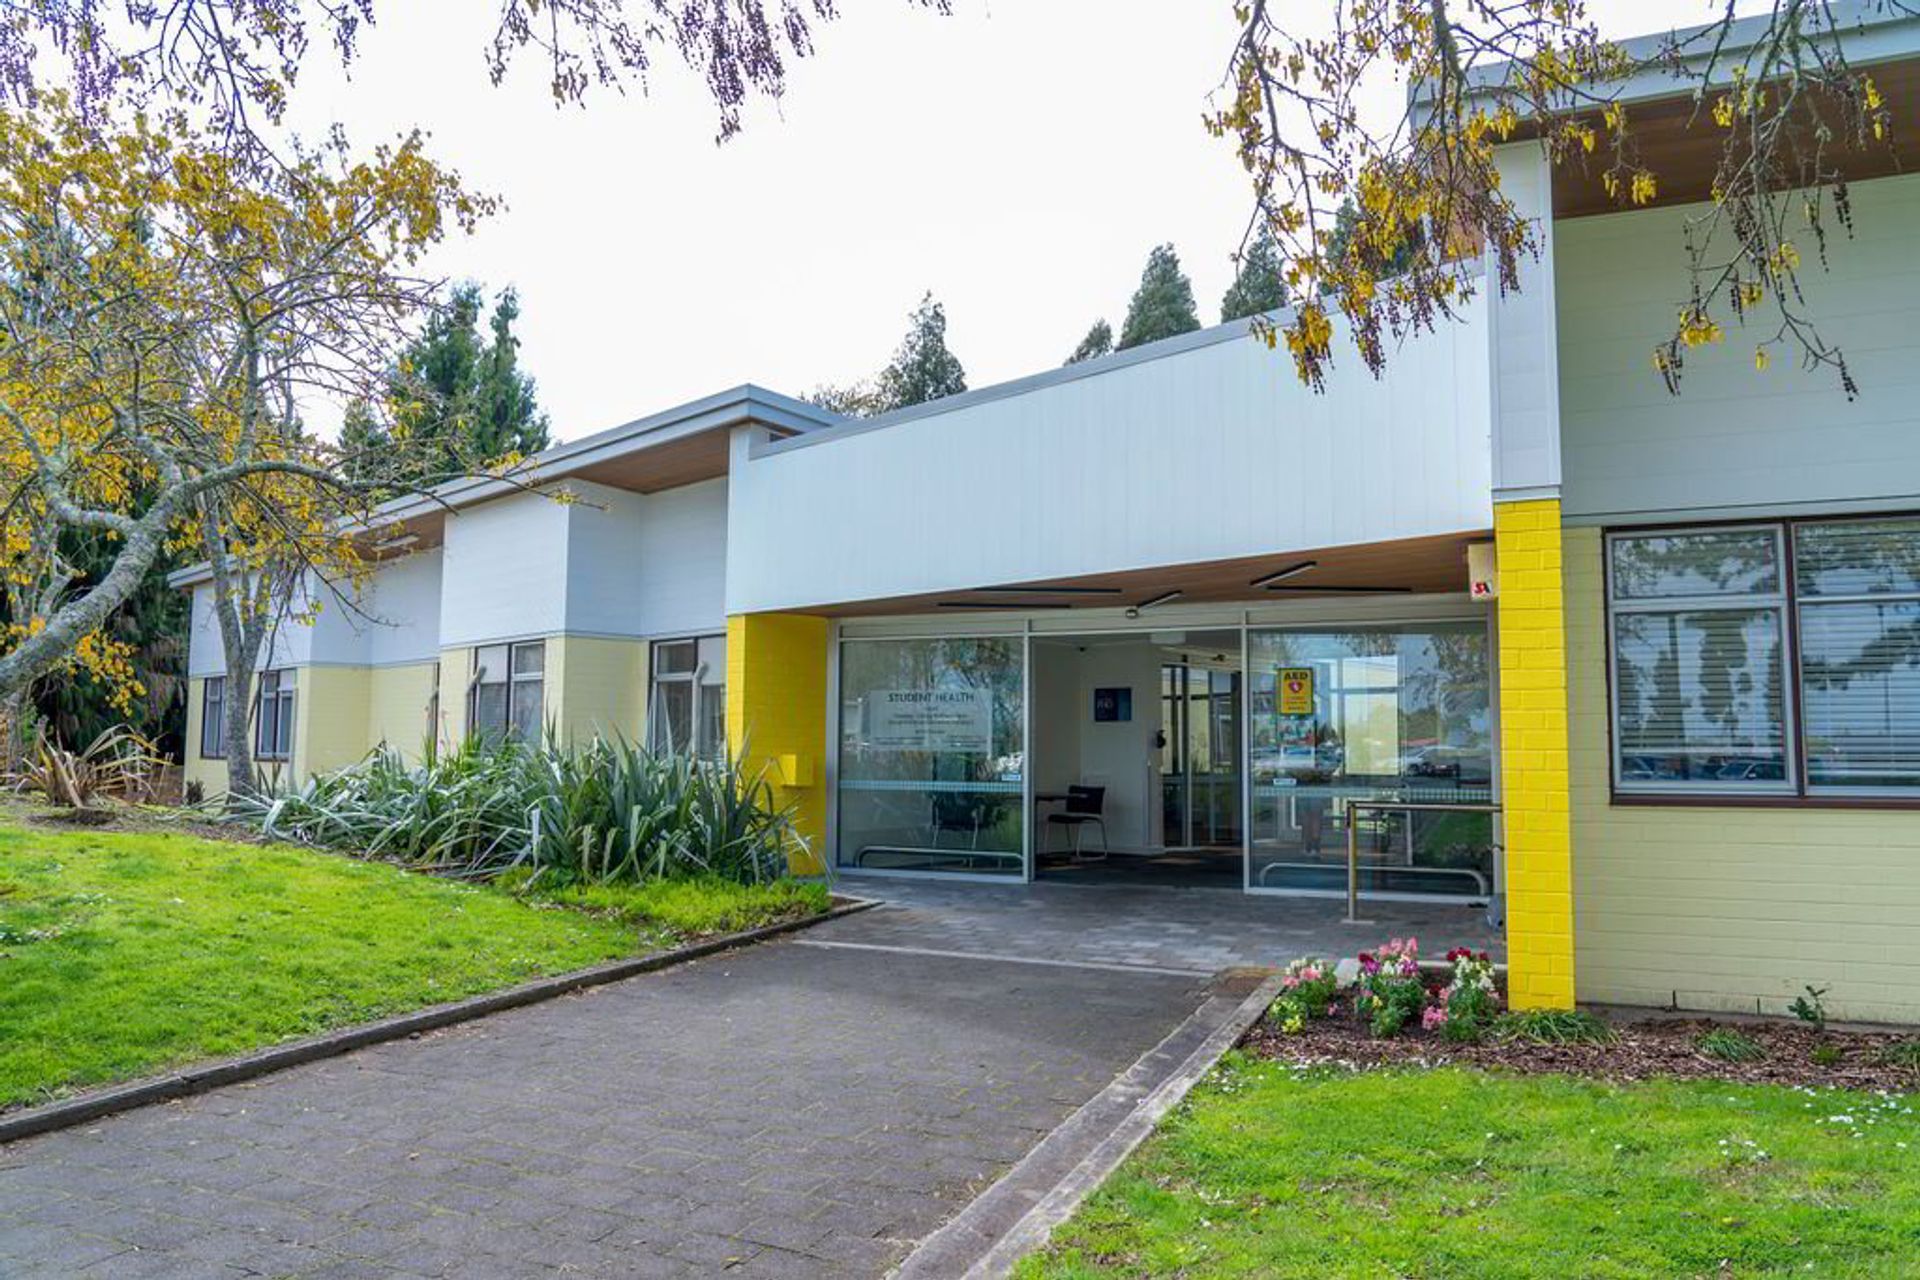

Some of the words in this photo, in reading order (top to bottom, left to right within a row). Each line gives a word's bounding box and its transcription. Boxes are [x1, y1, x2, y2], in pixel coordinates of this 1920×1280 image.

[1284, 672, 1308, 680] AED
[888, 692, 932, 703] STUDENT
[935, 692, 974, 703] HEALTH
